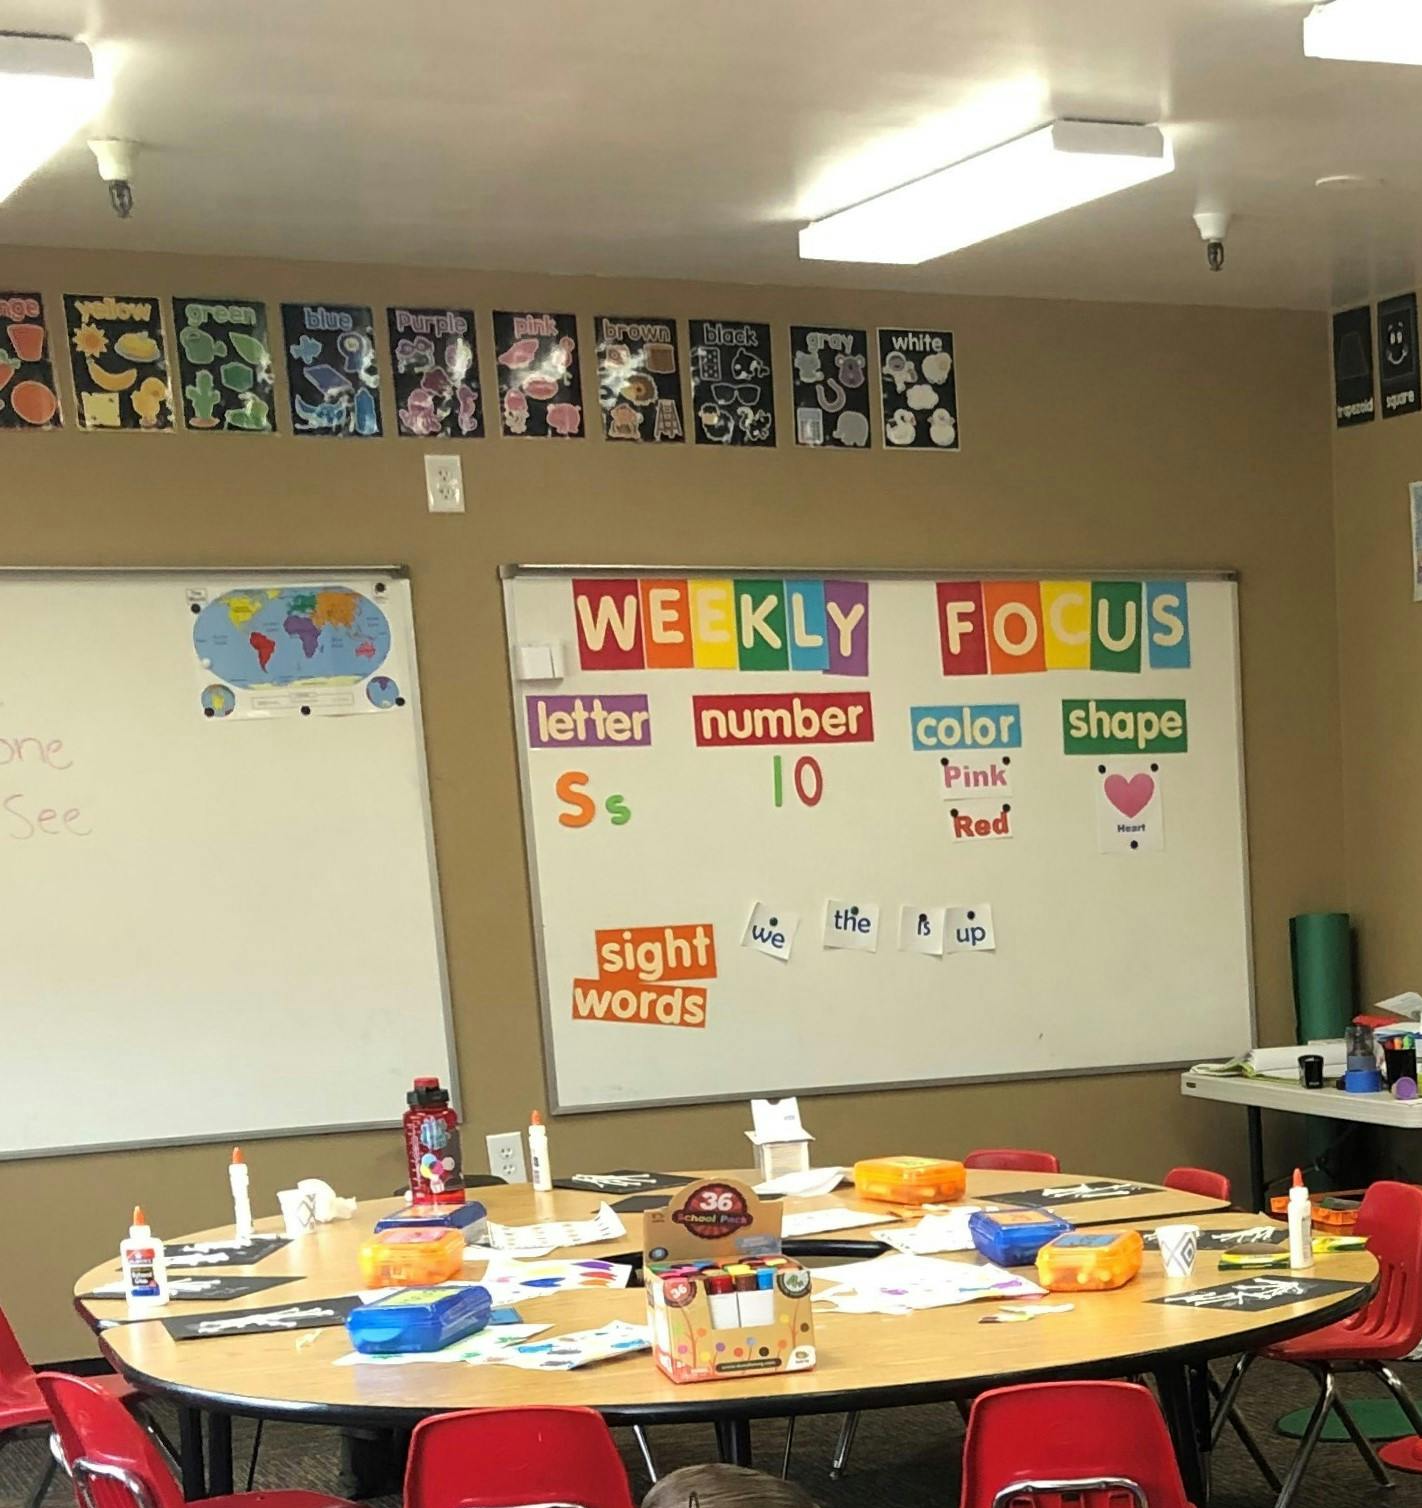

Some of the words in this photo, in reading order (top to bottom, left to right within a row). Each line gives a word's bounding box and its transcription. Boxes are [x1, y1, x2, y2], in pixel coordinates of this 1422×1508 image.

[74, 297, 152, 323] yellow
[184, 303, 257, 326] green
[303, 305, 353, 331] blue
[513, 315, 559, 338] pink
[602, 318, 671, 342] brown
[703, 324, 758, 348] black
[805, 331, 855, 355] gray
[891, 332, 944, 353] white
[576, 588, 866, 657] WEEKLY
[944, 593, 1185, 657] FOCUS
[537, 697, 649, 743] letter
[700, 697, 864, 740] number
[915, 706, 1016, 747] color
[1068, 700, 1184, 750] shape
[772, 754, 824, 808] 10
[943, 763, 1008, 790] Pink
[953, 811, 1011, 838] Red
[1116, 823, 1147, 834] Heart
[834, 908, 872, 936] the
[751, 922, 786, 950] we
[955, 926, 988, 947] up
[601, 929, 712, 982] sight
[573, 984, 705, 1026] words
[700, 1190, 733, 1212] 36
[677, 1212, 717, 1224] School
[719, 1214, 748, 1225] Pack
[669, 1284, 688, 1300] 36
